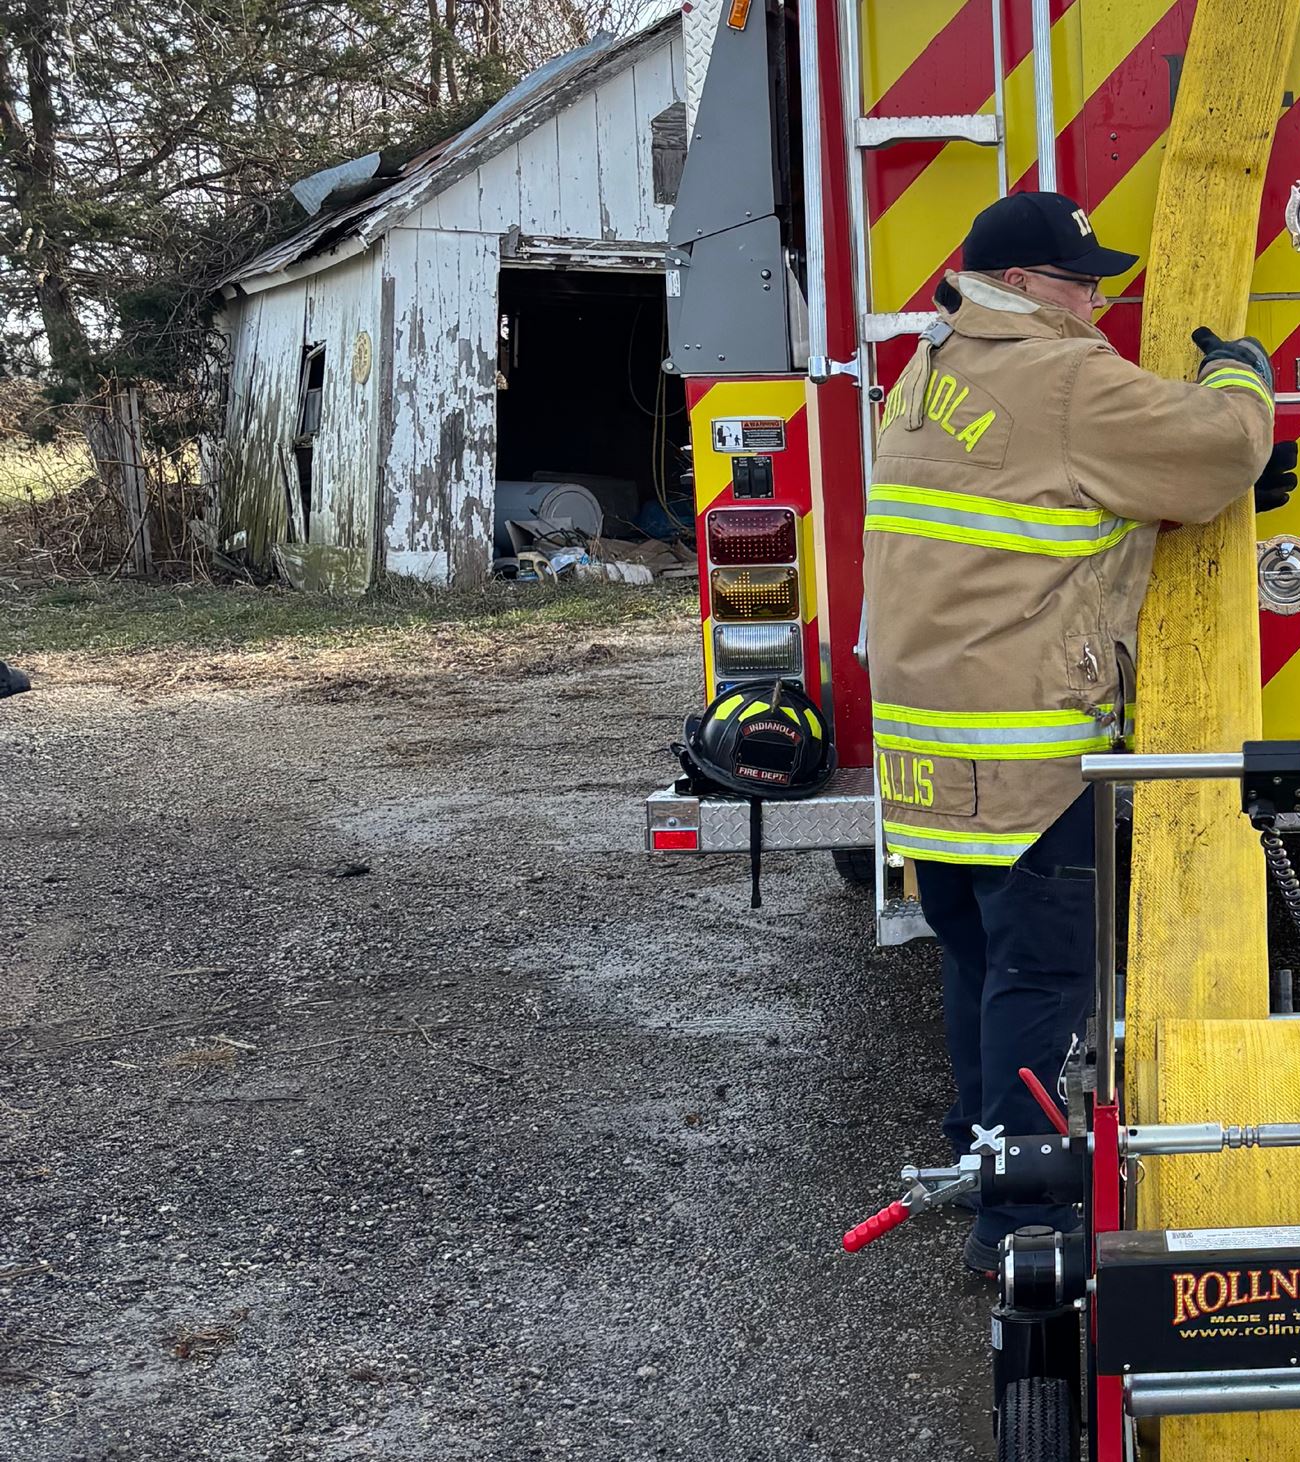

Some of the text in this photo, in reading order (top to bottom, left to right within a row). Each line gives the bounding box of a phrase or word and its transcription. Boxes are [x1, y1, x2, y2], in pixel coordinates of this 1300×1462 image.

[748, 722, 796, 739] INDIANOLA
[739, 767, 758, 777] FIRE
[1210, 1313, 1261, 1324] MADE
[1268, 1313, 1286, 1322] IN
